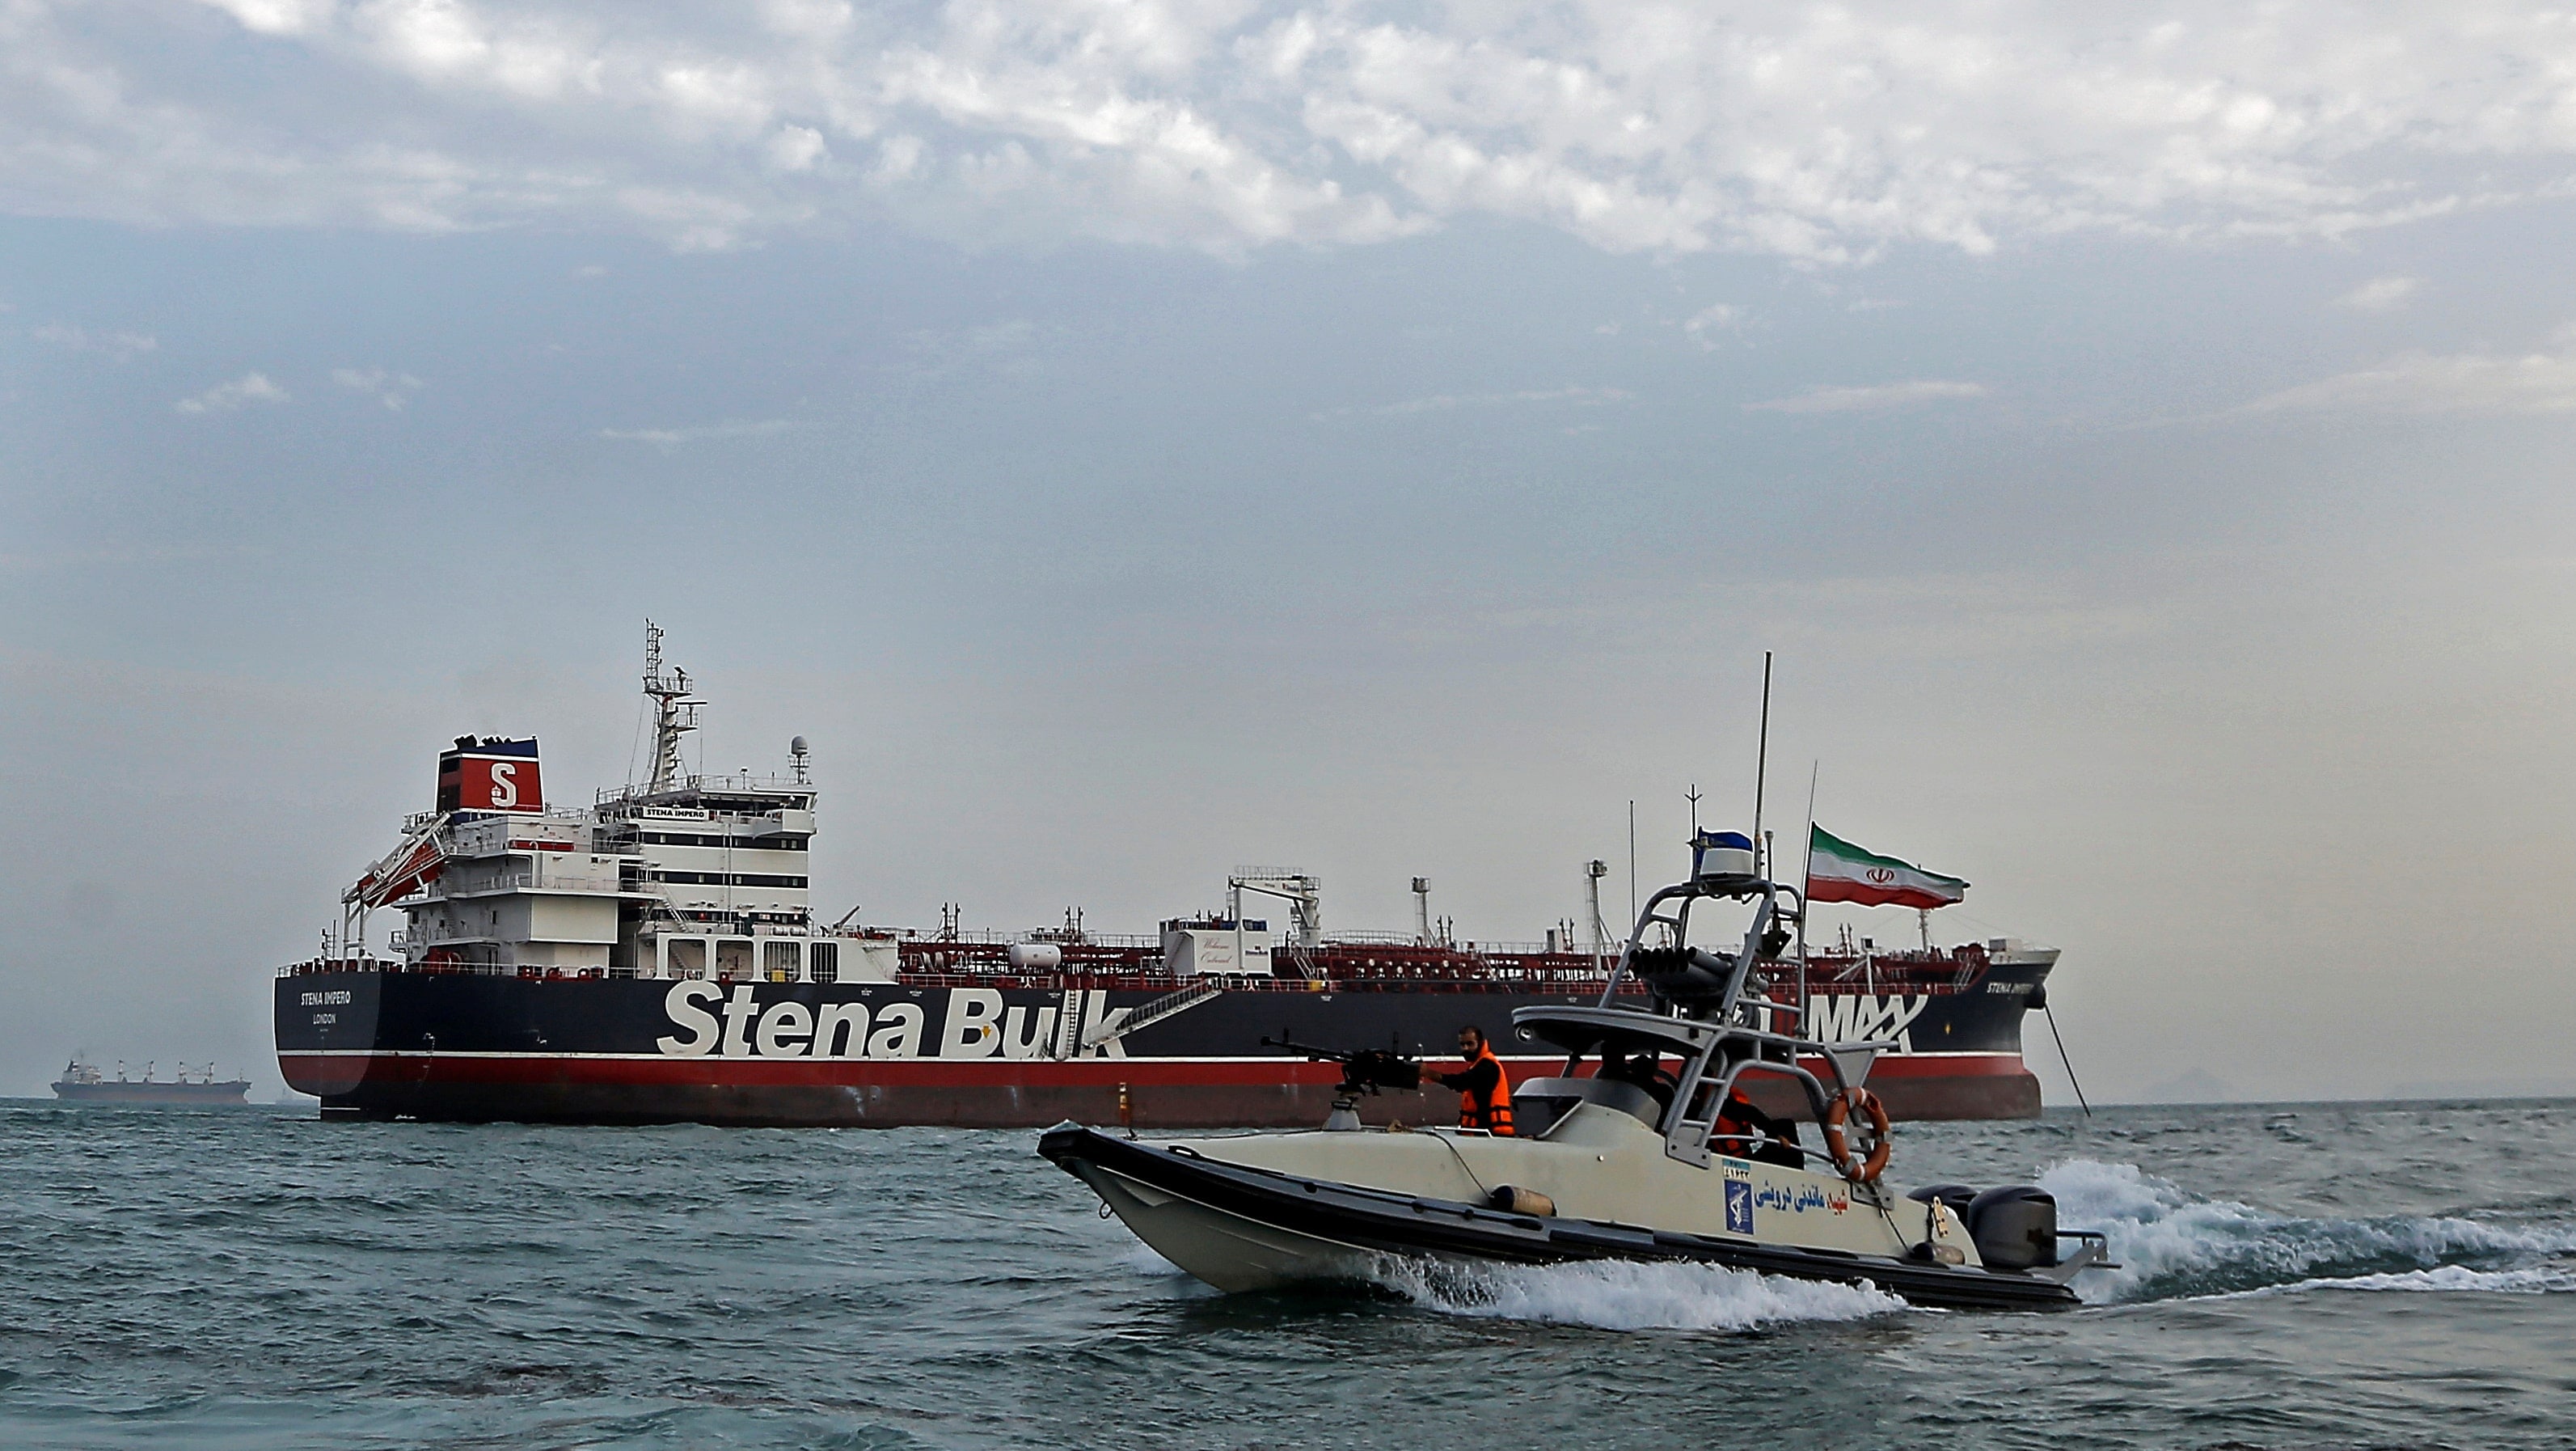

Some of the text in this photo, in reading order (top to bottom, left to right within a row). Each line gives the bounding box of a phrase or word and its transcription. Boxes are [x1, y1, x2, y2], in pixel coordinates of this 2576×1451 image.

[492, 763, 517, 807] S
[647, 809, 673, 817] STENA
[301, 990, 351, 1006] STENA IMPERO
[313, 1013, 336, 1025] LONDON
[656, 980, 1136, 1060] Stena Bulk
